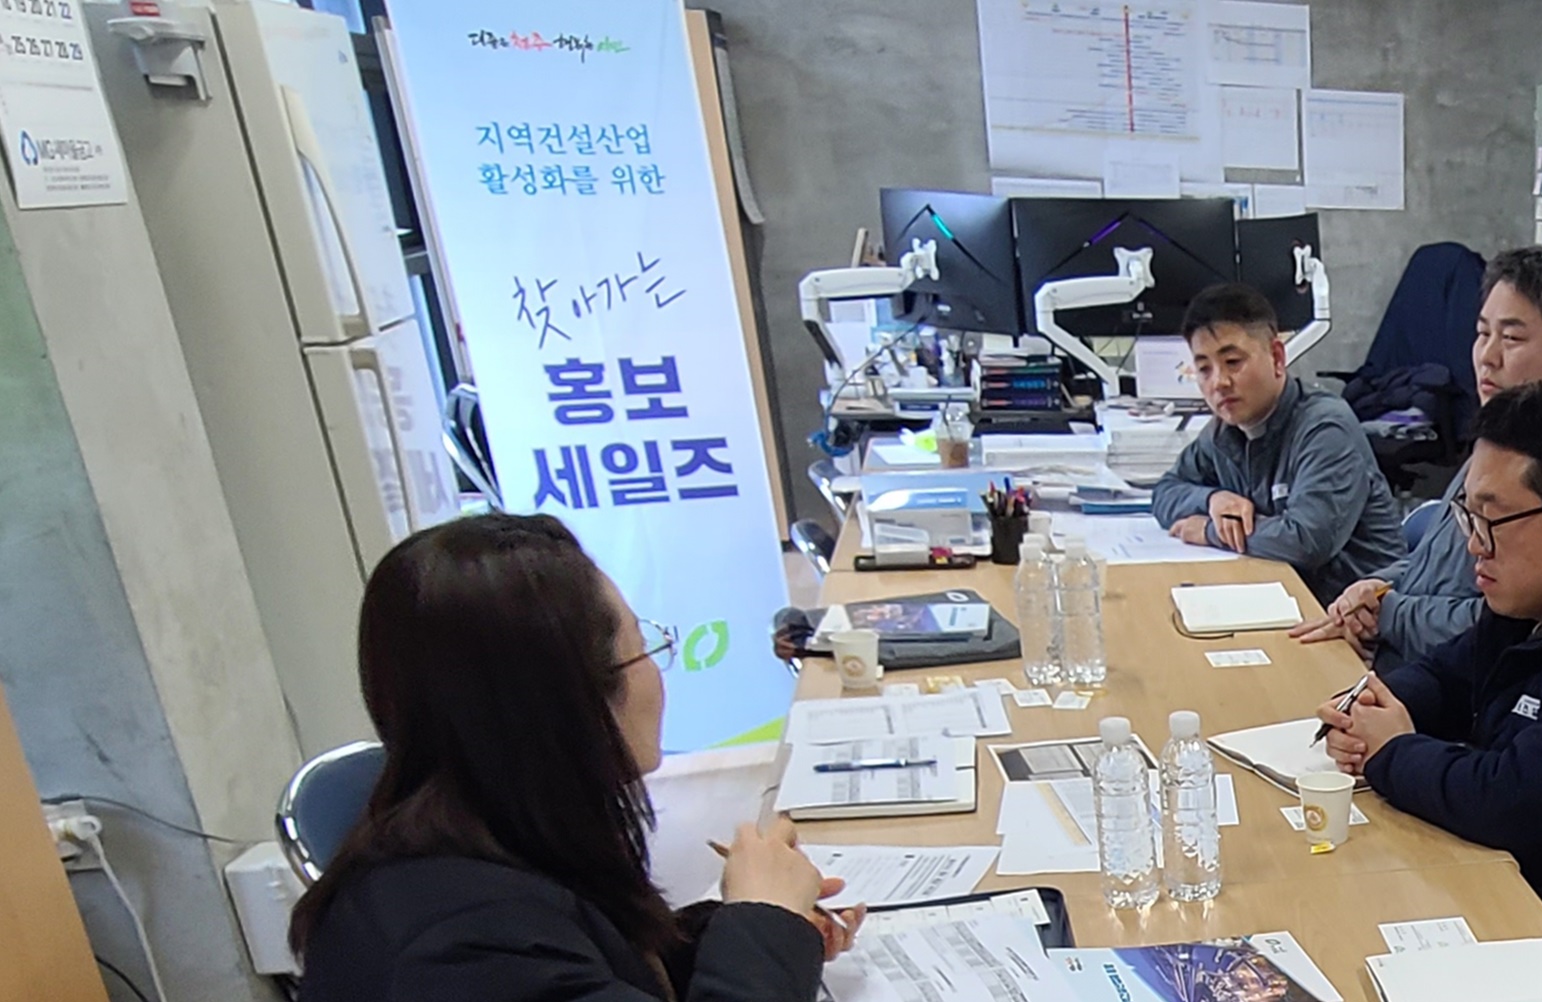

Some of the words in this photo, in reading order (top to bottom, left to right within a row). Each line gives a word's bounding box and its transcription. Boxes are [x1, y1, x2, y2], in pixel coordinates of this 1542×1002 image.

[58, 1, 72, 20] 22
[11, 35, 26, 55] 25
[26, 37, 41, 57] 26
[40, 39, 54, 58] 27
[54, 41, 70, 59] 28
[69, 42, 84, 61] 29
[476, 122, 651, 155] 지역건설산업
[478, 163, 598, 196] 활성화를
[611, 164, 665, 195] 위한
[513, 252, 687, 349] 찾아가는
[543, 356, 689, 426] 홍보
[532, 437, 740, 510] 세일즈
